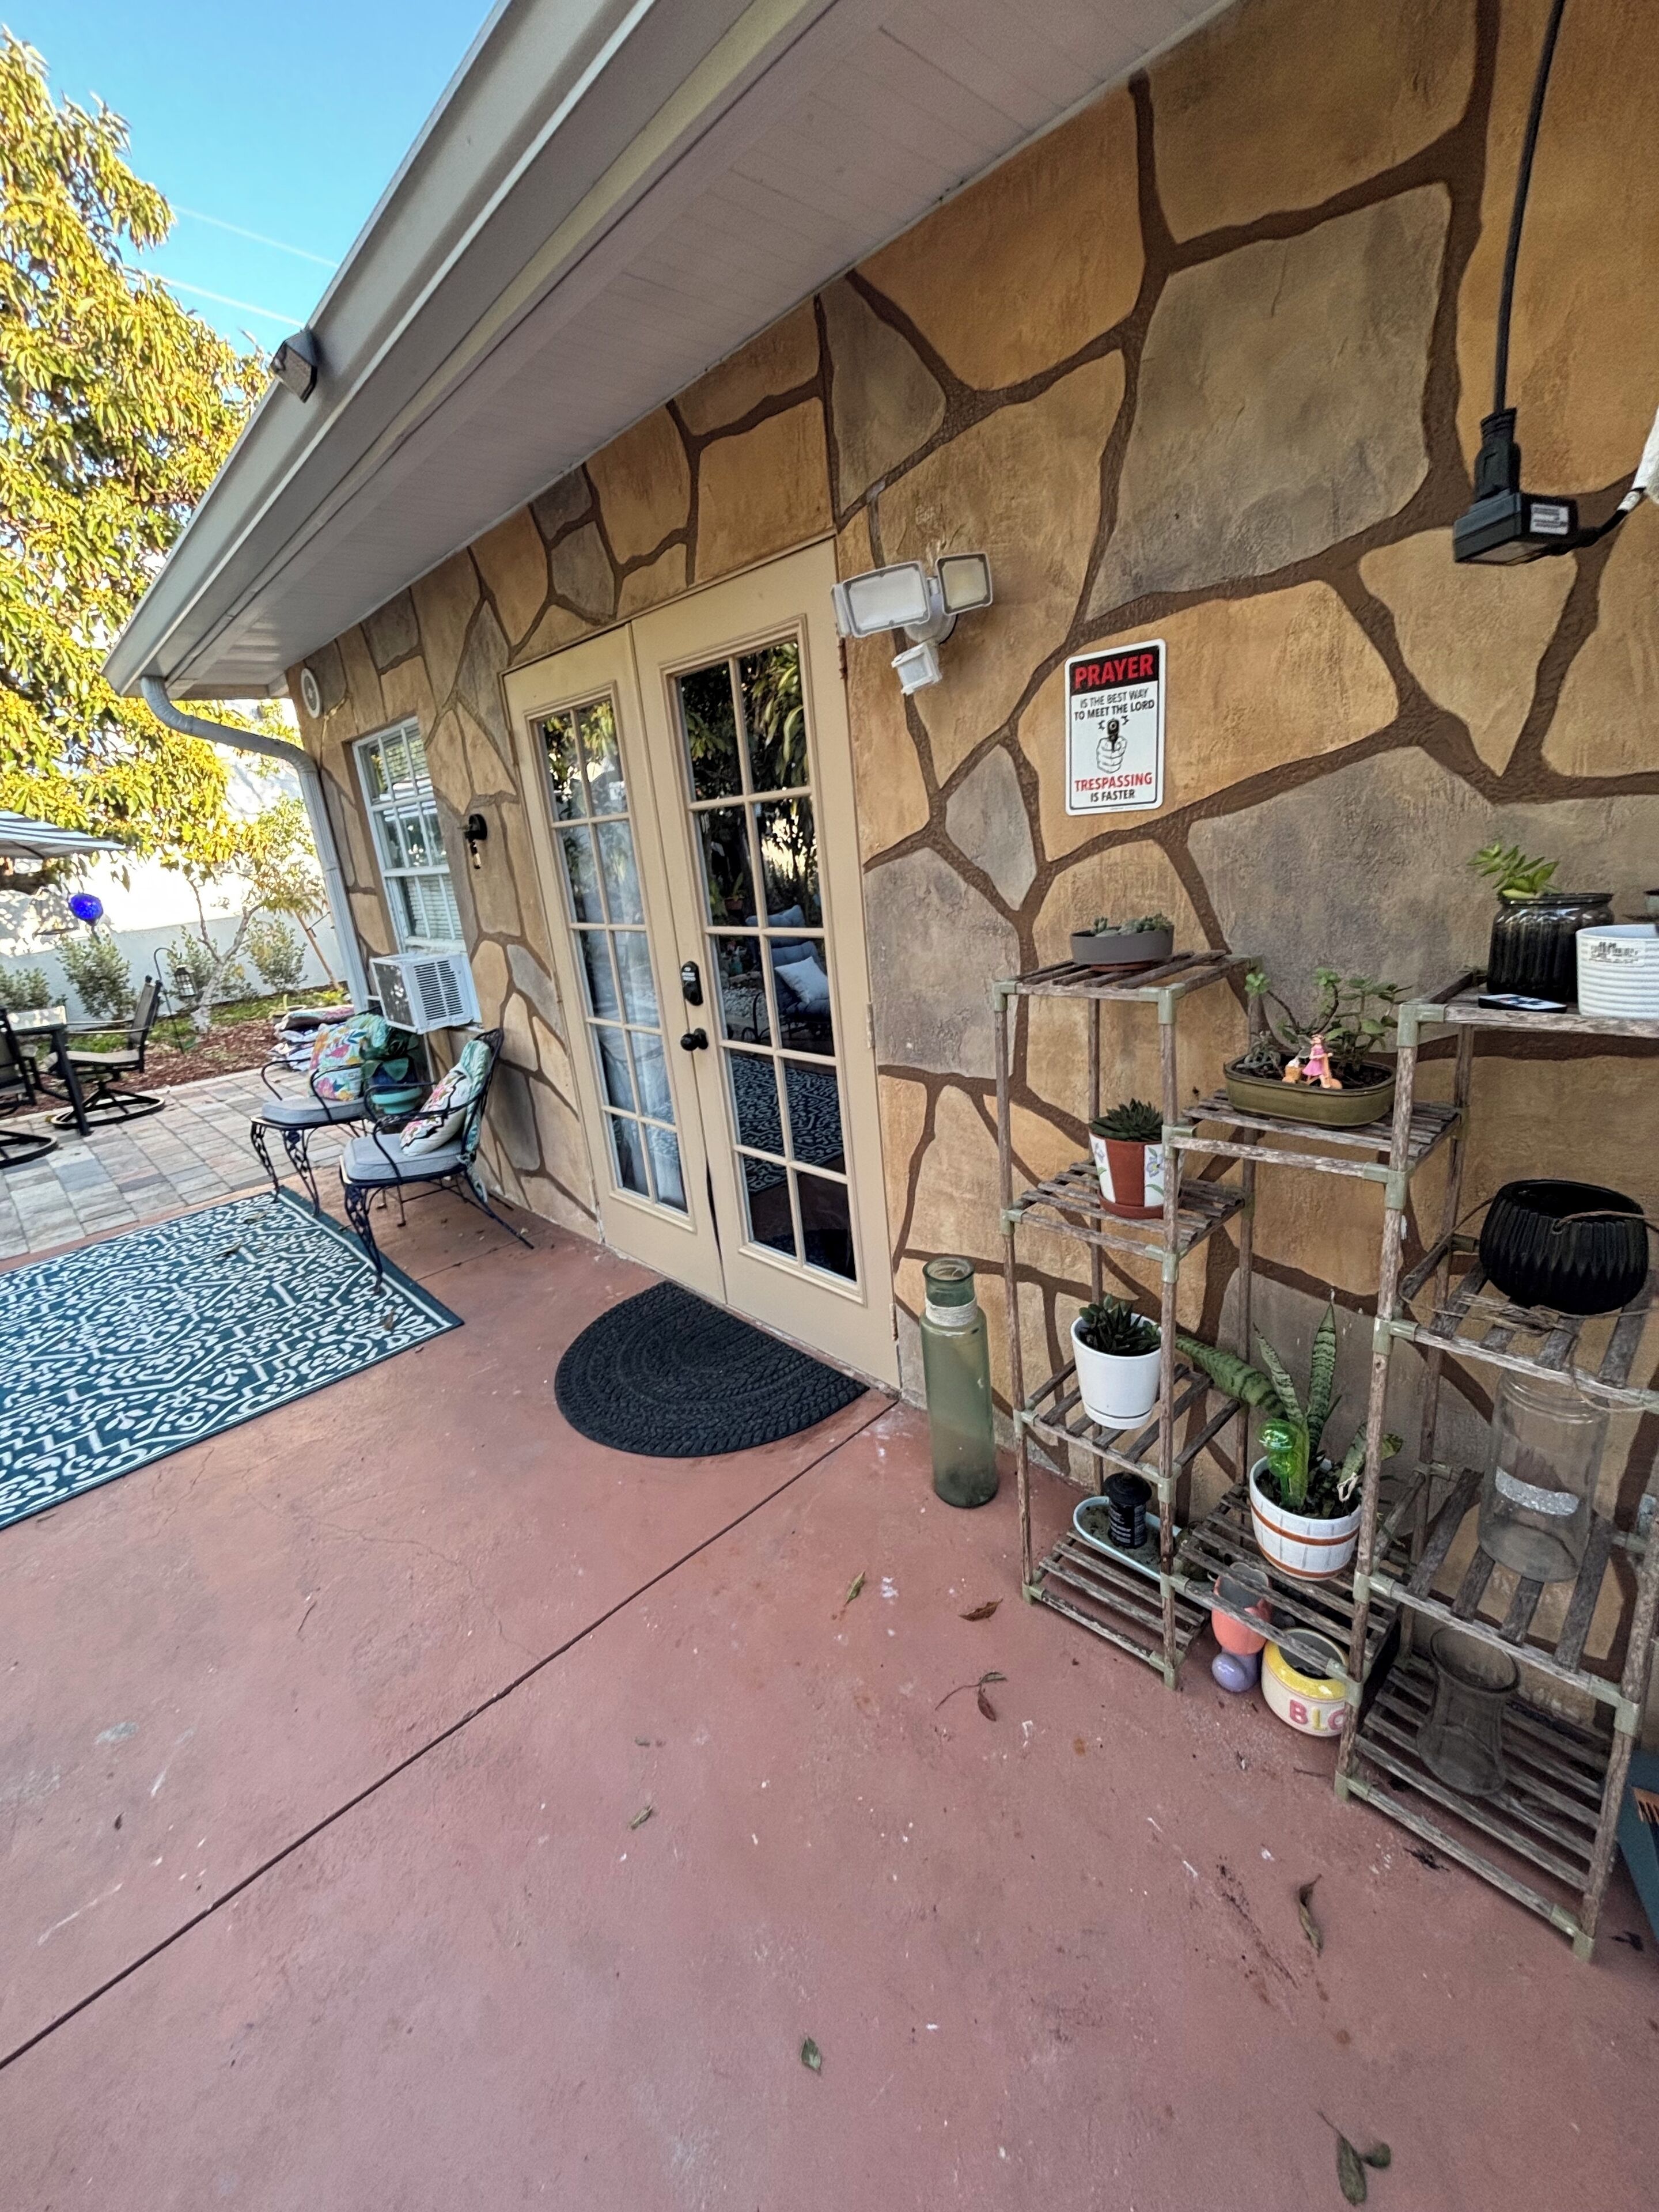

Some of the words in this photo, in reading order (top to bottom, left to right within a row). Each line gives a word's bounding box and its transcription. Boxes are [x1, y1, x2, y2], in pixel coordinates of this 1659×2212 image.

[1075, 654, 1154, 688] PRAYER
[1080, 698, 1088, 709] IS
[1090, 695, 1104, 707] THE
[1107, 692, 1127, 704] BEST
[1129, 688, 1149, 700] WAY
[1074, 711, 1085, 721] TO
[1087, 706, 1109, 719] MEET
[1111, 703, 1128, 715] THE
[1130, 699, 1155, 712] LORD
[1074, 772, 1153, 792] TRESPASSING
[1090, 791, 1099, 802] IS
[1101, 789, 1135, 801] FASTER
